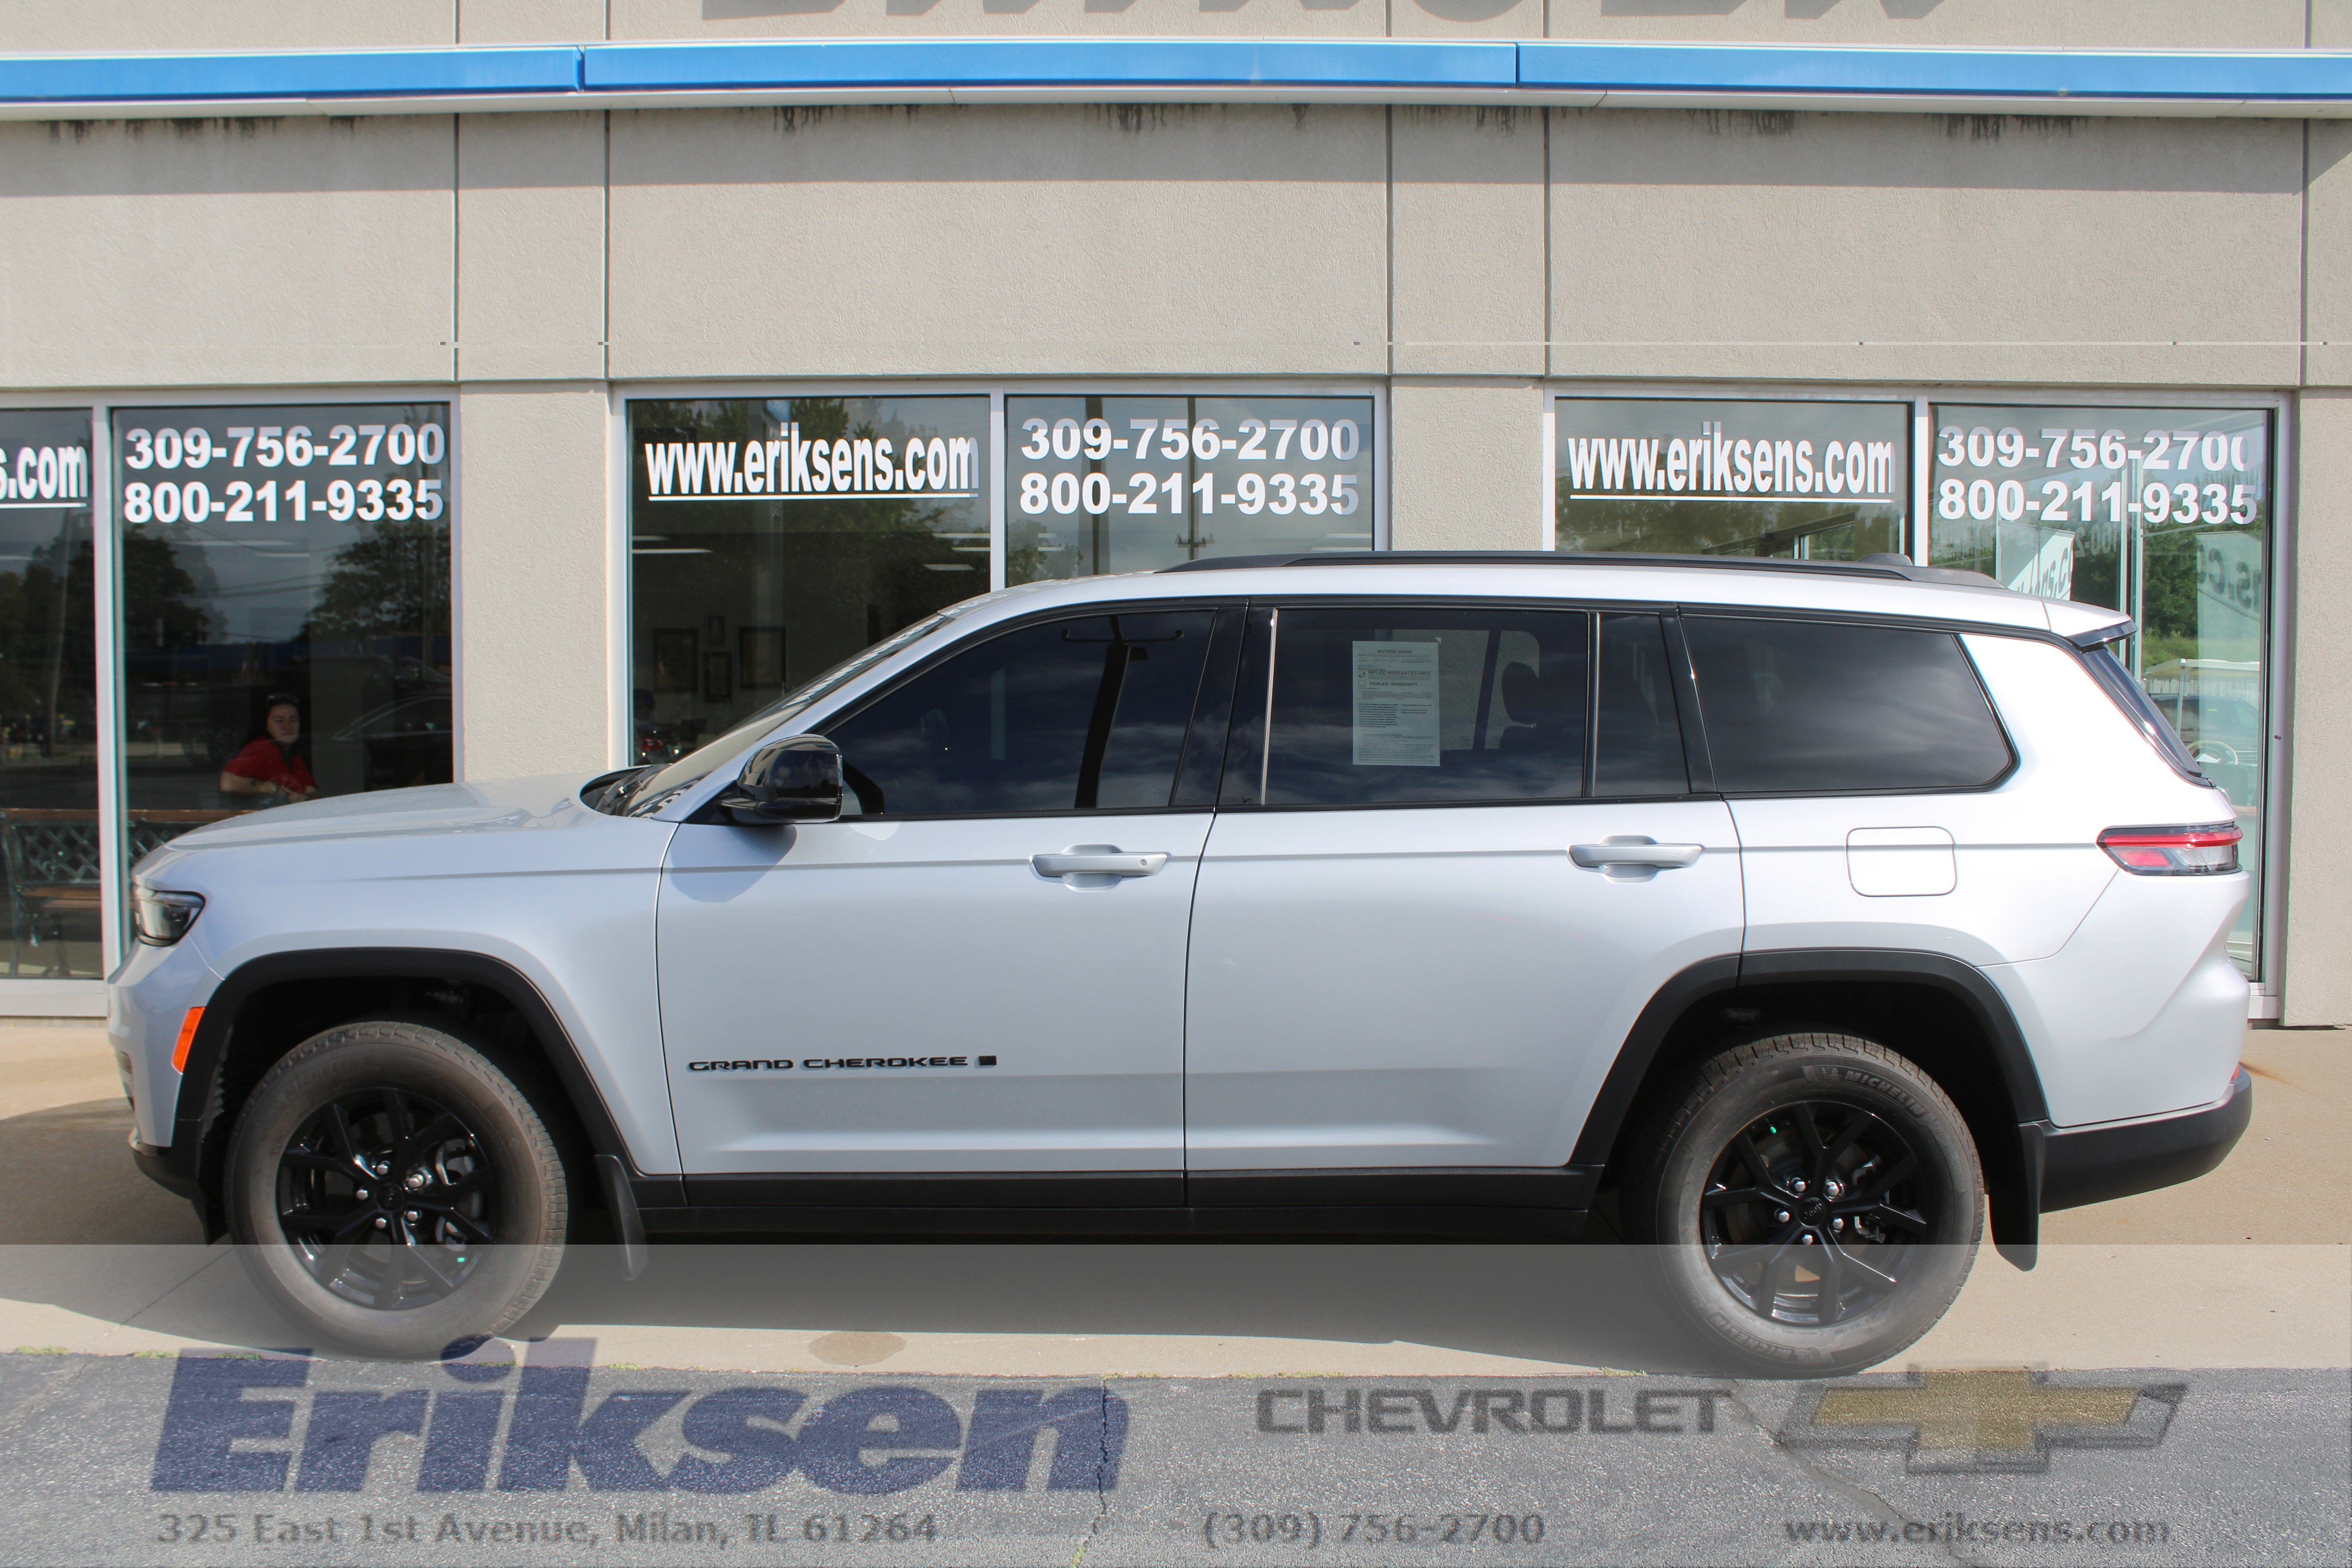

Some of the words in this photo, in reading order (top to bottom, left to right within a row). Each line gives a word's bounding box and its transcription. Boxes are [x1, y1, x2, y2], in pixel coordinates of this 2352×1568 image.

[125, 423, 445, 470] 309-756-2700
[645, 422, 979, 495] www.eriksens.com
[1021, 418, 1360, 461] 309-756-2700
[1567, 421, 1895, 494] www.eriksens.com
[1937, 426, 2257, 472] 309-756-2700
[124, 479, 444, 523] 800-211-9335
[1020, 472, 1359, 515] 800-211-9335
[1938, 479, 2257, 525] 800-211-9335
[688, 1059, 794, 1071] GRAND
[803, 1056, 969, 1069] CHEROKEE
[1844, 1071, 1925, 1116] MICHELIN
[1710, 1314, 1793, 1359] MICHELIN
